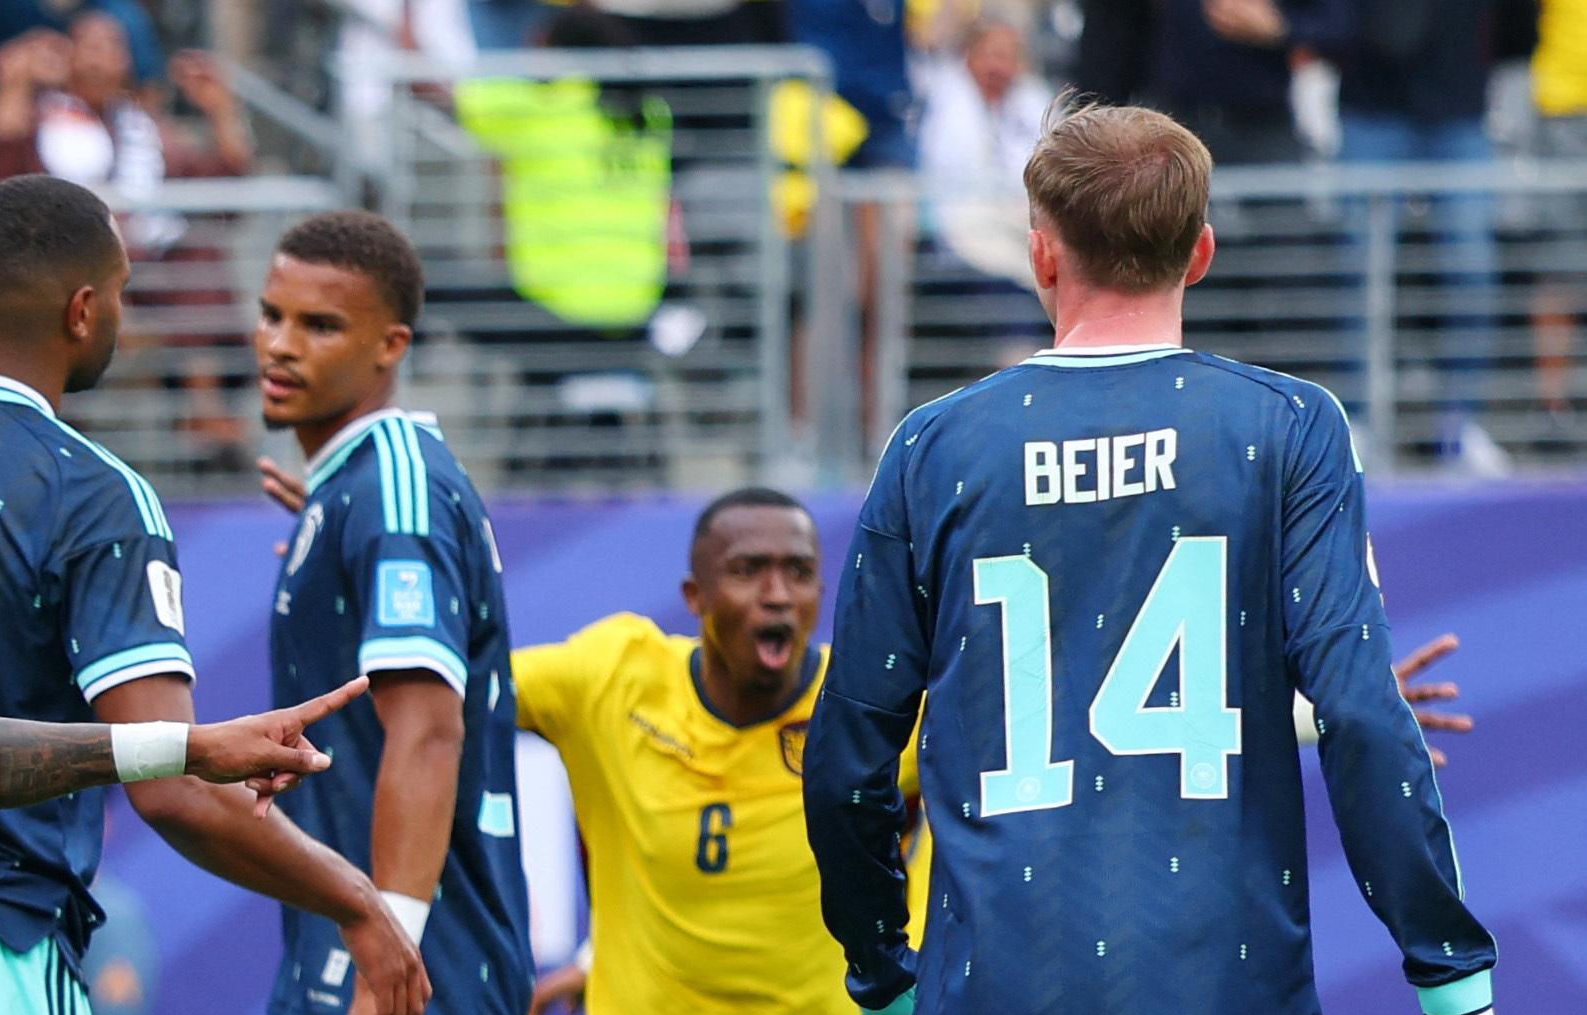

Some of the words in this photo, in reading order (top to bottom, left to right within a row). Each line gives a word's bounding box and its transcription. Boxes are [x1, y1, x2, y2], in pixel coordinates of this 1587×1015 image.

[1024, 427, 1177, 506] BEIER
[972, 535, 1242, 818] 14
[696, 802, 733, 876] 6
